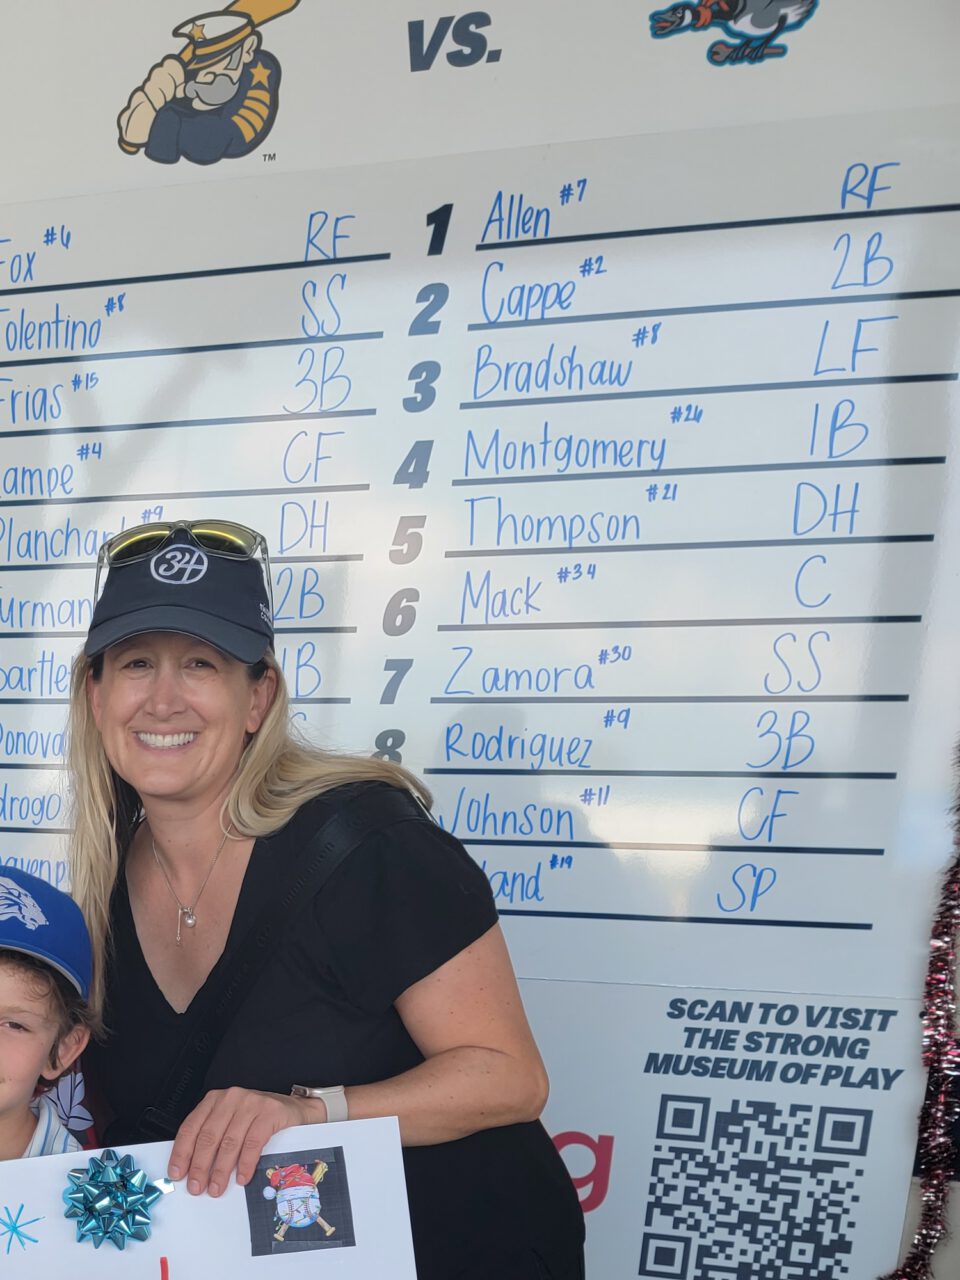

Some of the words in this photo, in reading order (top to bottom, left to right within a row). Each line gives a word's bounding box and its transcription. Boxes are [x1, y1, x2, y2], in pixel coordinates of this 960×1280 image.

[408, 12, 502, 72] VS.
[481, 190, 551, 243] Allen
[560, 178, 588, 205] #7
[840, 161, 904, 211] RF
[304, 211, 356, 262] RF
[427, 204, 453, 256] 1
[478, 262, 579, 326] Cappe
[578, 255, 607, 277] #2
[832, 231, 894, 290] 2B
[105, 293, 125, 317] #8
[298, 273, 350, 340] SS
[408, 283, 449, 336] 2
[72, 372, 97, 390] #15
[282, 346, 352, 414] 3B
[473, 340, 637, 402] Bradshaw
[631, 322, 662, 348] #8
[813, 316, 897, 379] LF
[403, 361, 441, 413] 3
[78, 444, 102, 460] #4
[282, 431, 345, 484] CF
[393, 440, 434, 489] 4
[464, 422, 666, 480] Montgomery
[809, 399, 869, 462] 1B
[278, 500, 331, 554] DH
[389, 515, 427, 564] 5
[464, 496, 640, 551] Thompson
[645, 484, 678, 503] #21
[792, 481, 859, 536] DH
[273, 566, 326, 622] 2B
[383, 588, 419, 636] 6
[460, 572, 540, 624] Mack
[556, 563, 597, 584] #34
[795, 554, 831, 608] C
[380, 659, 413, 704] 7
[443, 646, 593, 698] Zamora
[599, 645, 631, 664] #30
[763, 631, 830, 695] SS
[372, 728, 406, 766] 8
[441, 722, 592, 772] Rodriguez
[604, 708, 630, 728] #9
[747, 711, 815, 774] 3B
[440, 786, 575, 841] Johnson
[580, 785, 611, 805] #11
[738, 787, 800, 844] CF
[481, 860, 545, 904] and
[550, 854, 573, 869] #19
[716, 864, 777, 912] SP
[667, 998, 751, 1023] SCAN
[759, 1003, 799, 1025] TO
[806, 1006, 898, 1031] VISIT
[684, 1027, 740, 1051] THE
[743, 1031, 870, 1060] STRONG
[644, 1053, 777, 1082] MUSEUM
[776, 1061, 821, 1084] OF
[817, 1064, 904, 1090] PLAY
